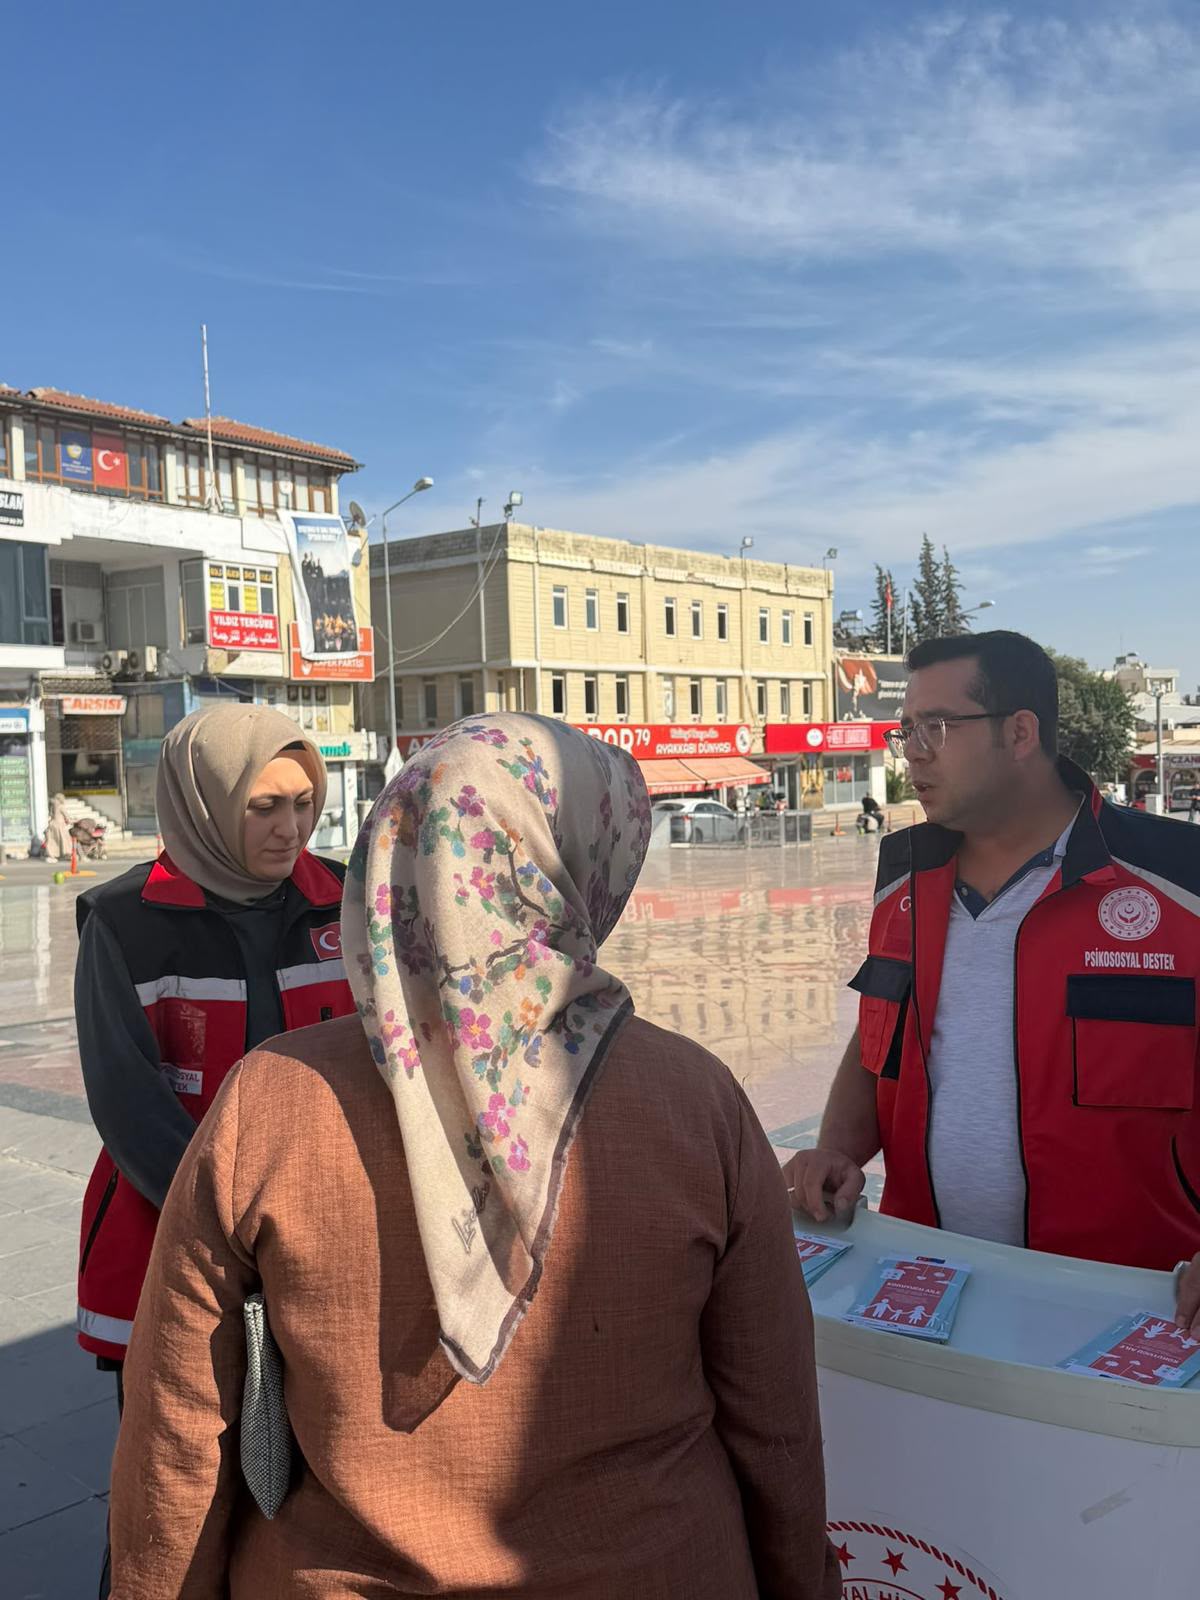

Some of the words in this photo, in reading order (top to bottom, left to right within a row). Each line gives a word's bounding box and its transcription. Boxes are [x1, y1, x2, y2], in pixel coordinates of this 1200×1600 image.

[656, 744, 697, 755] AYAKKABI
[698, 741, 732, 753] DÜNYASI
[1084, 947, 1141, 969] PSİKOSOSYAL
[1143, 953, 1175, 971] DESTEK
